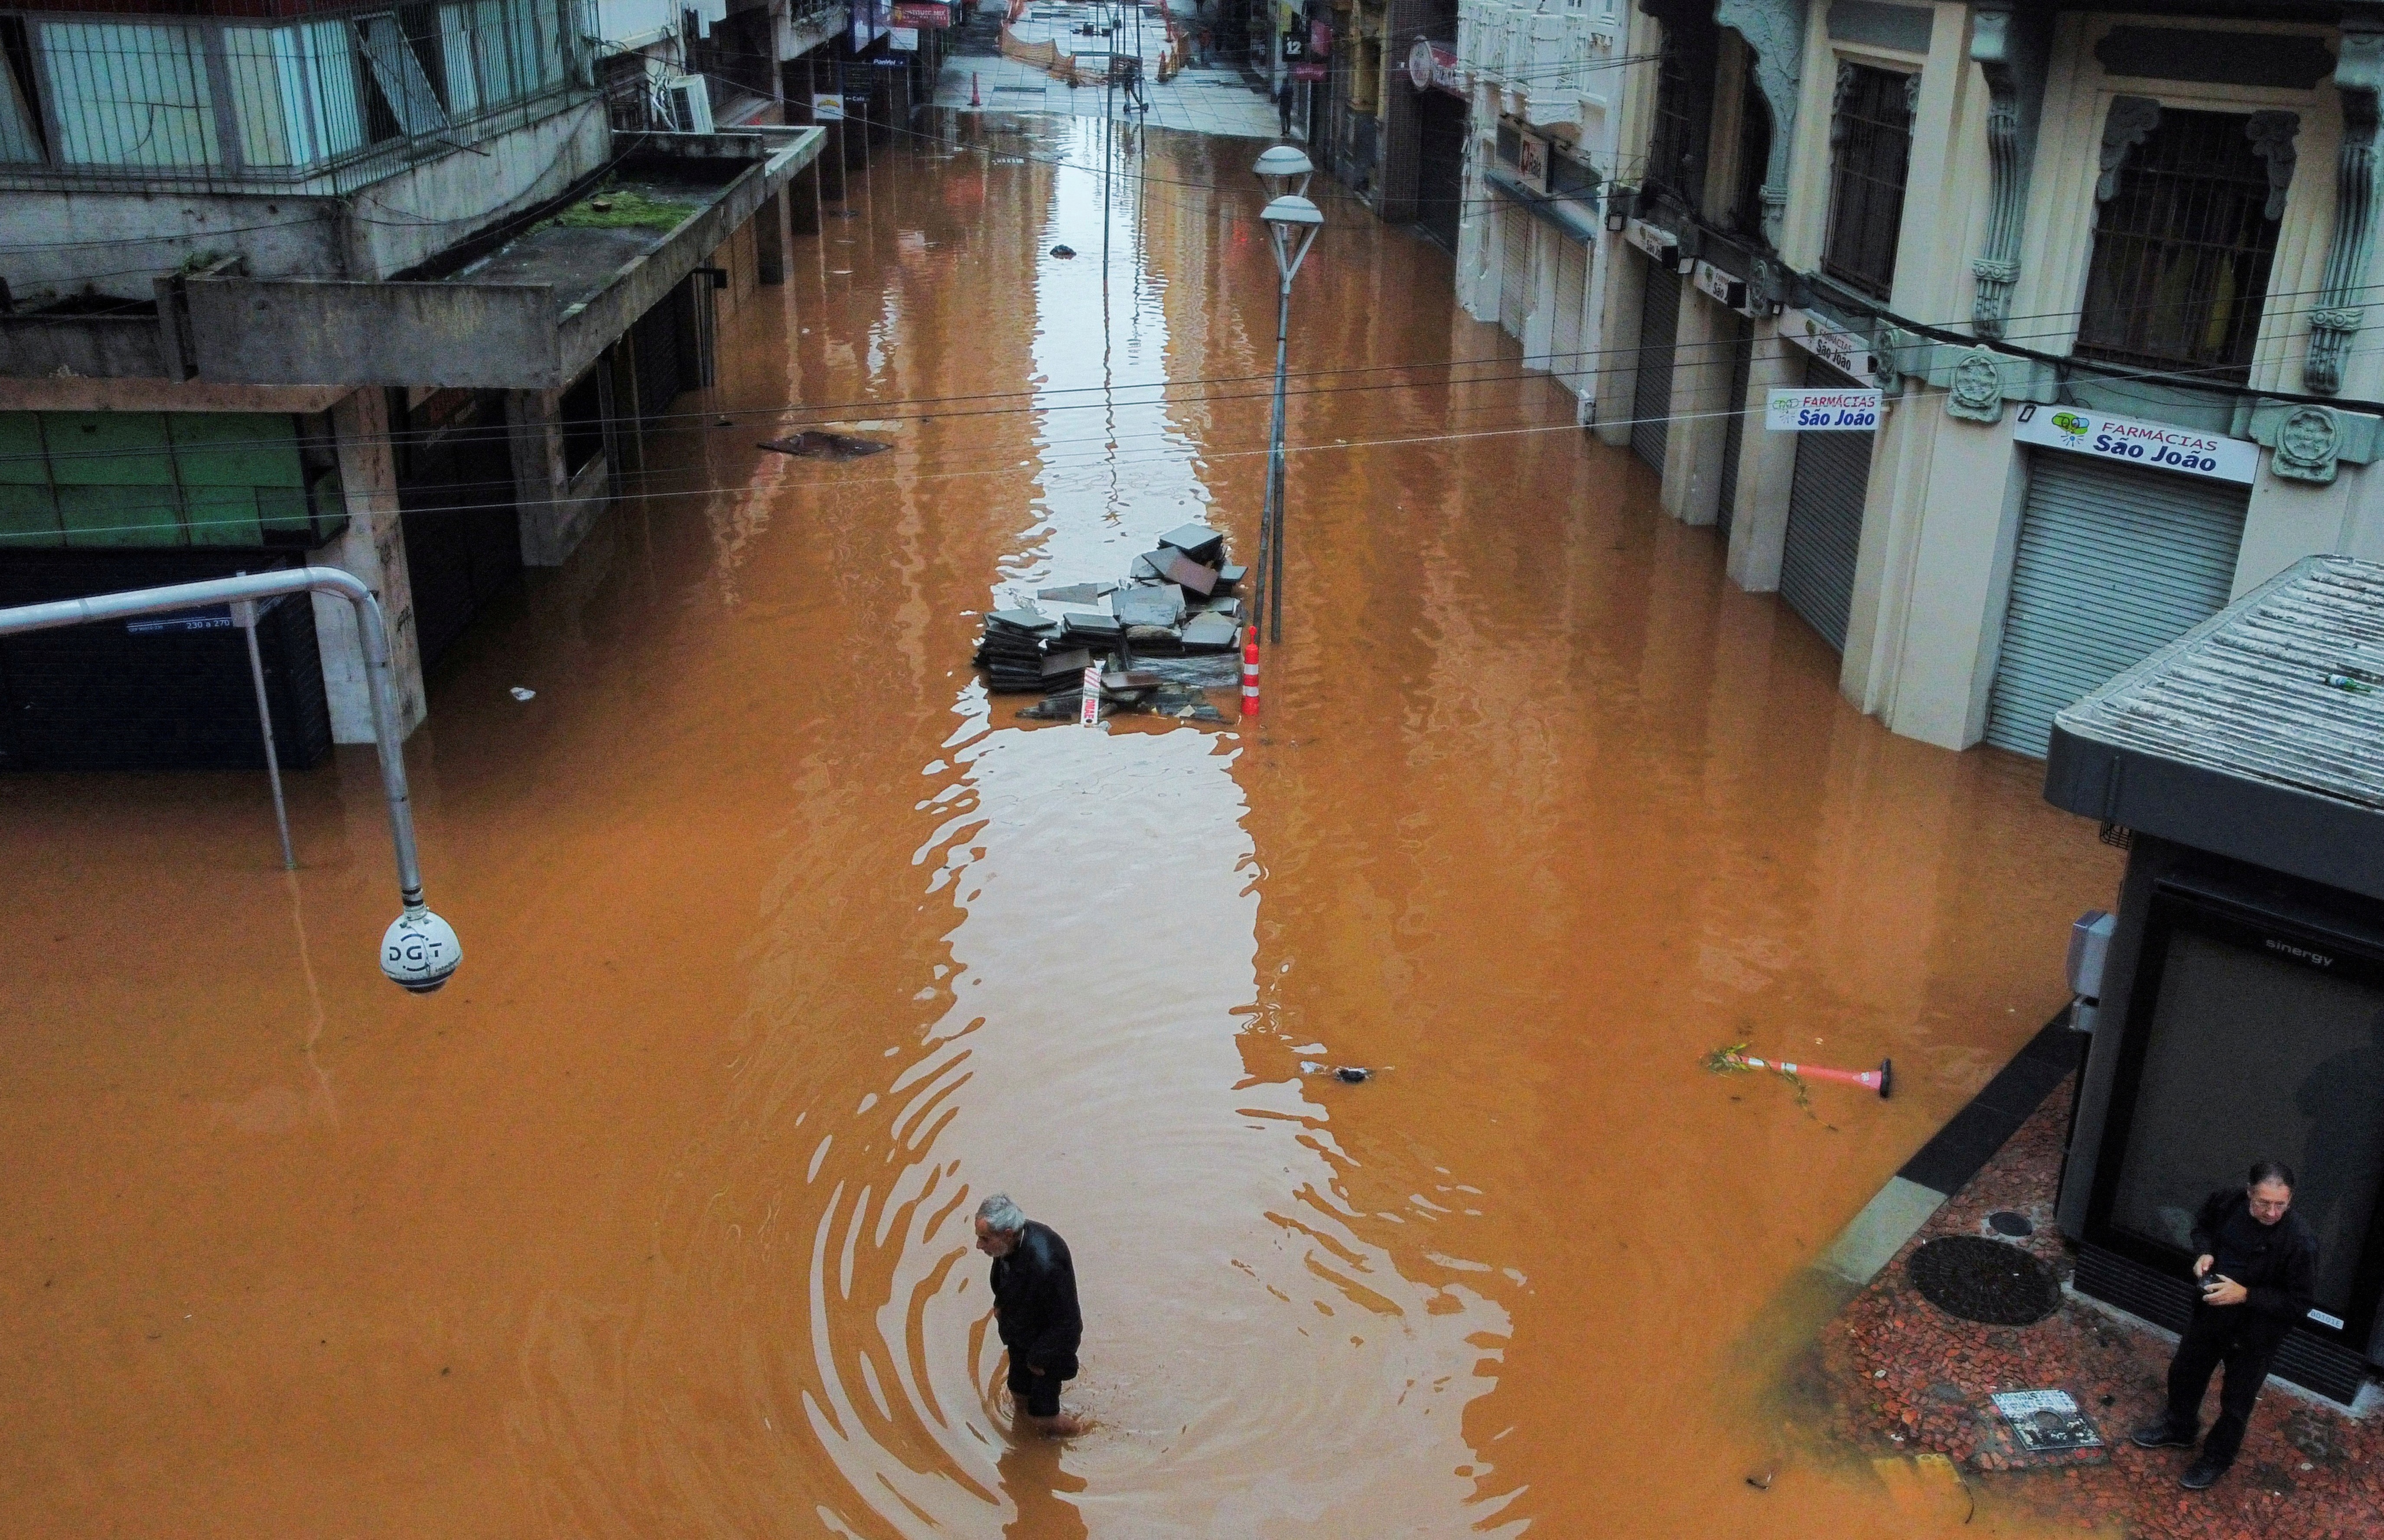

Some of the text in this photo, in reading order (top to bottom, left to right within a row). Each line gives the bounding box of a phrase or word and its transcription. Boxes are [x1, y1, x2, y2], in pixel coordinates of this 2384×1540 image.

[1817, 339, 1851, 371] São João
[1803, 394, 1876, 407] FARMÁCIAS
[1798, 408, 1875, 426] São João
[2102, 422, 2218, 451] FARMÁCIAS
[2093, 434, 2216, 472] São João
[186, 621, 203, 629] 230
[2266, 939, 2333, 967] sinergy
